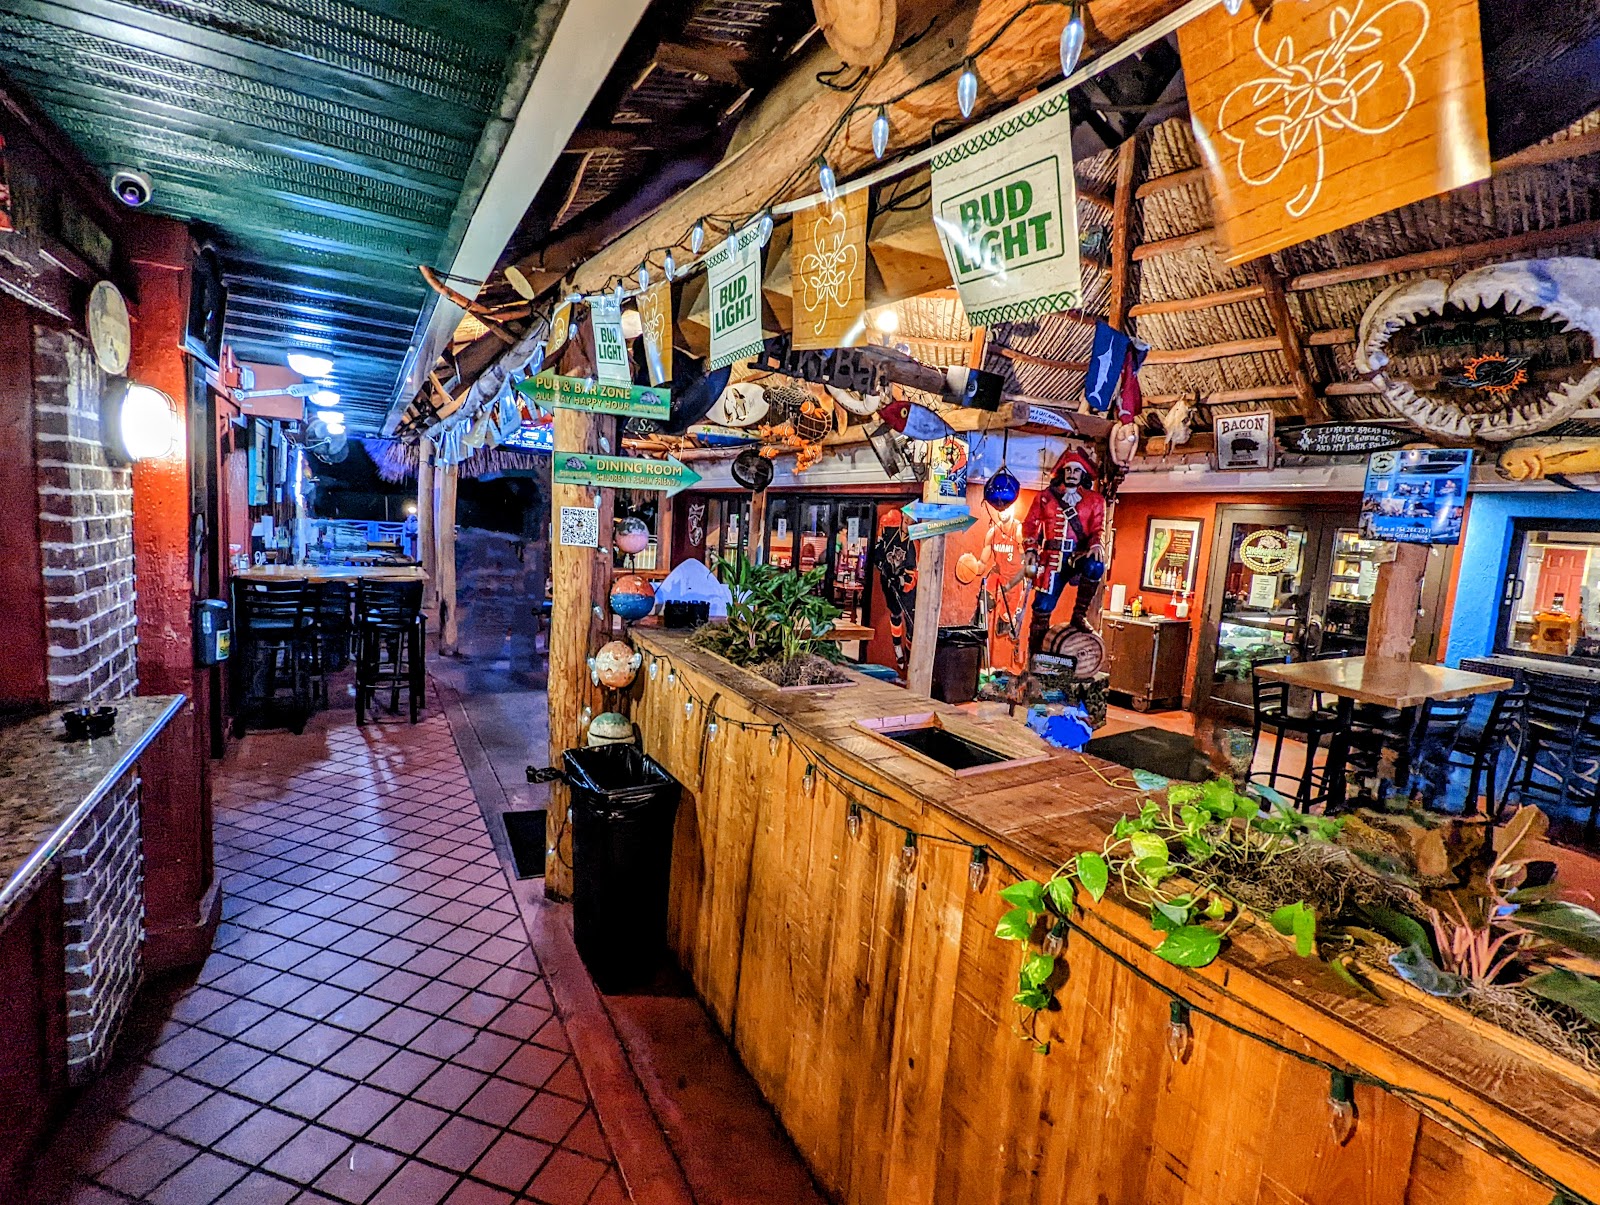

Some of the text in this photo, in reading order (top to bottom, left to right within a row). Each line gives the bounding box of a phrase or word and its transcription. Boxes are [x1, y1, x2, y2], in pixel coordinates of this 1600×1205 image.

[959, 180, 1033, 237] BUD
[719, 275, 747, 309] BUD
[715, 294, 753, 333] LIGHT
[600, 327, 617, 344] BUD
[598, 344, 623, 361] LIGHT
[535, 377, 560, 391] PUB
[563, 381, 571, 392] &
[600, 385, 631, 400] ZONE
[535, 392, 551, 401] ALL
[574, 396, 603, 409] HAPPY
[605, 401, 631, 411] HOUR
[1221, 417, 1264, 435] BACON
[597, 459, 683, 477] DINING ROOM
[1007, 552, 1013, 562] 3
